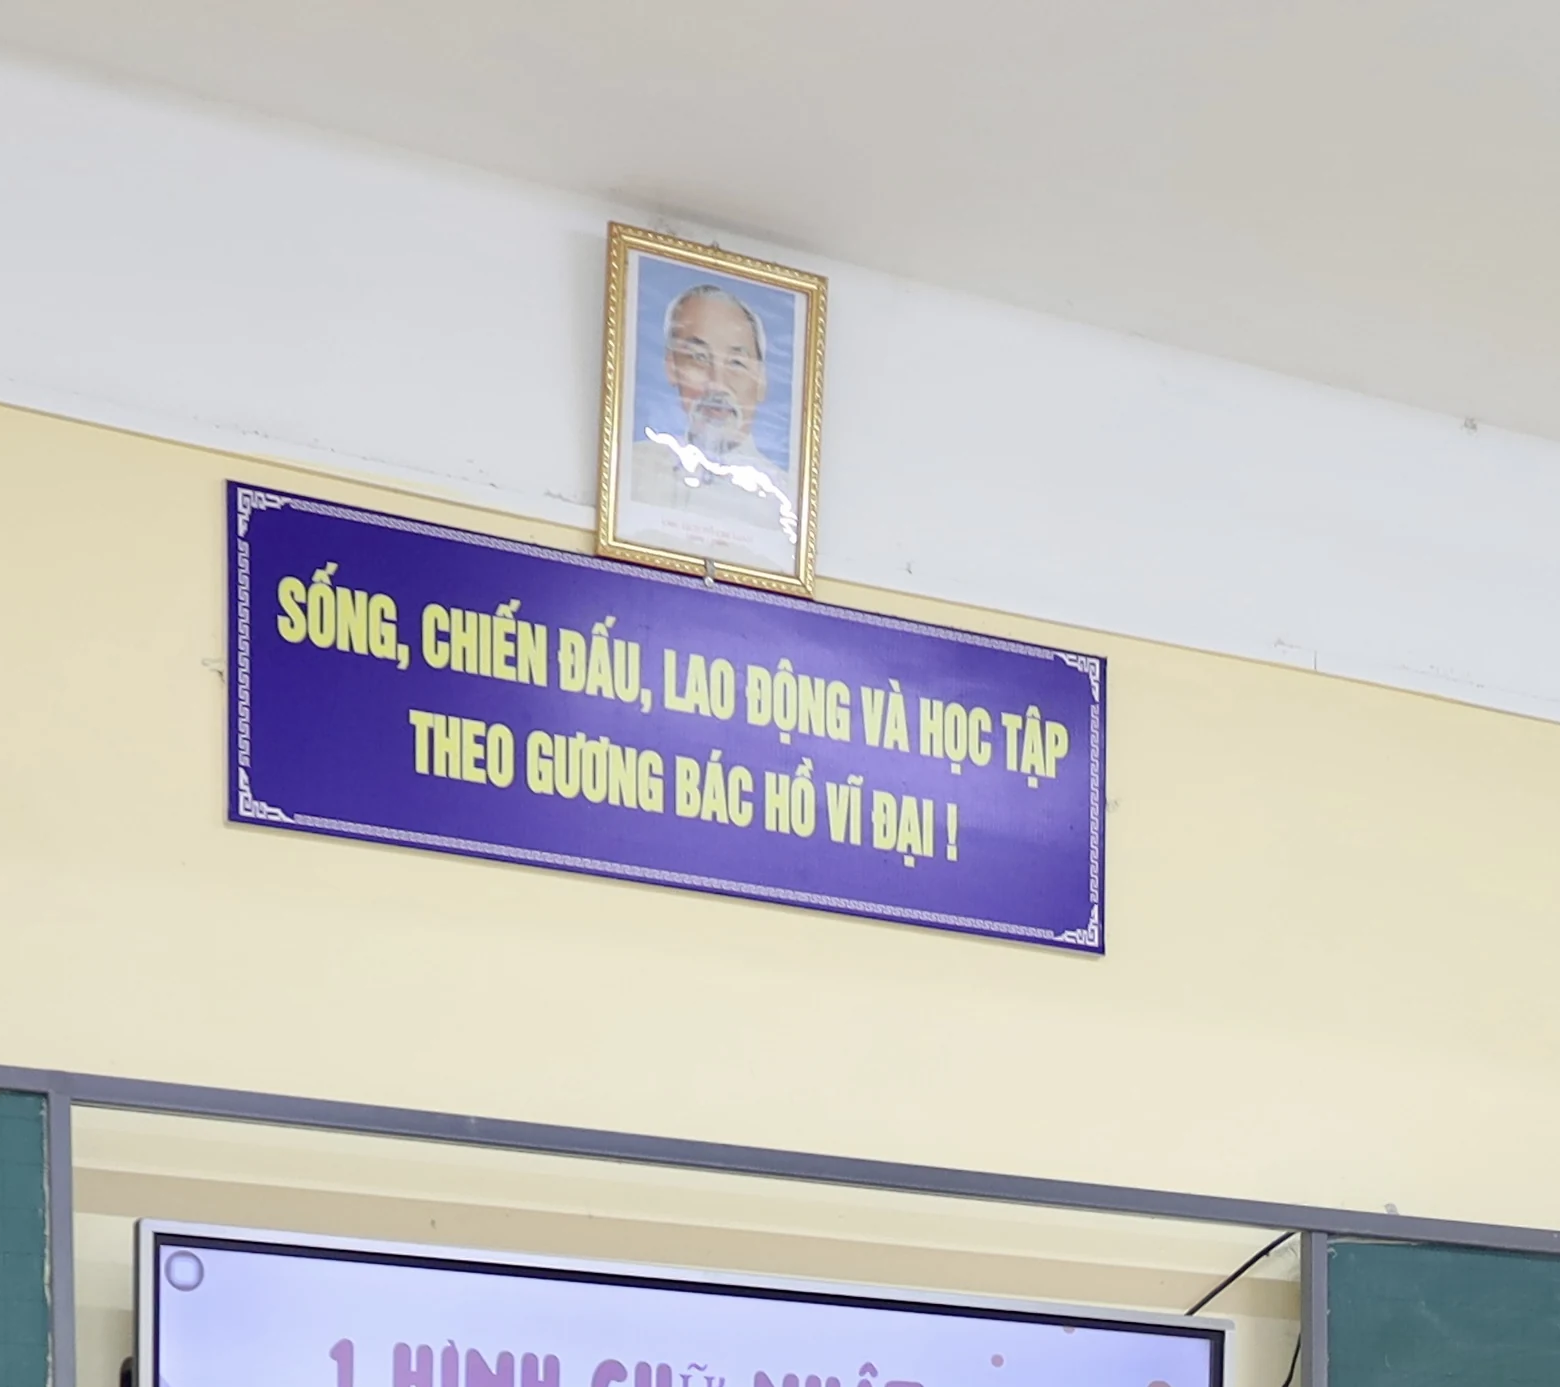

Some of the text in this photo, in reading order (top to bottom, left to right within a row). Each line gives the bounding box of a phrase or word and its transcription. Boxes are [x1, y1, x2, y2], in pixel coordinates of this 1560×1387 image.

[277, 562, 1069, 788] SỐNG, CHIẾN ĐẤU, LAO ĐỘNG VÀ HỌC TẬP
[409, 709, 515, 788] THEO
[526, 730, 664, 814] GƯƠNG
[675, 749, 753, 828] BÁC
[764, 757, 815, 838] HỒ
[826, 774, 863, 846] VĨ
[871, 789, 934, 868] ĐẠI
